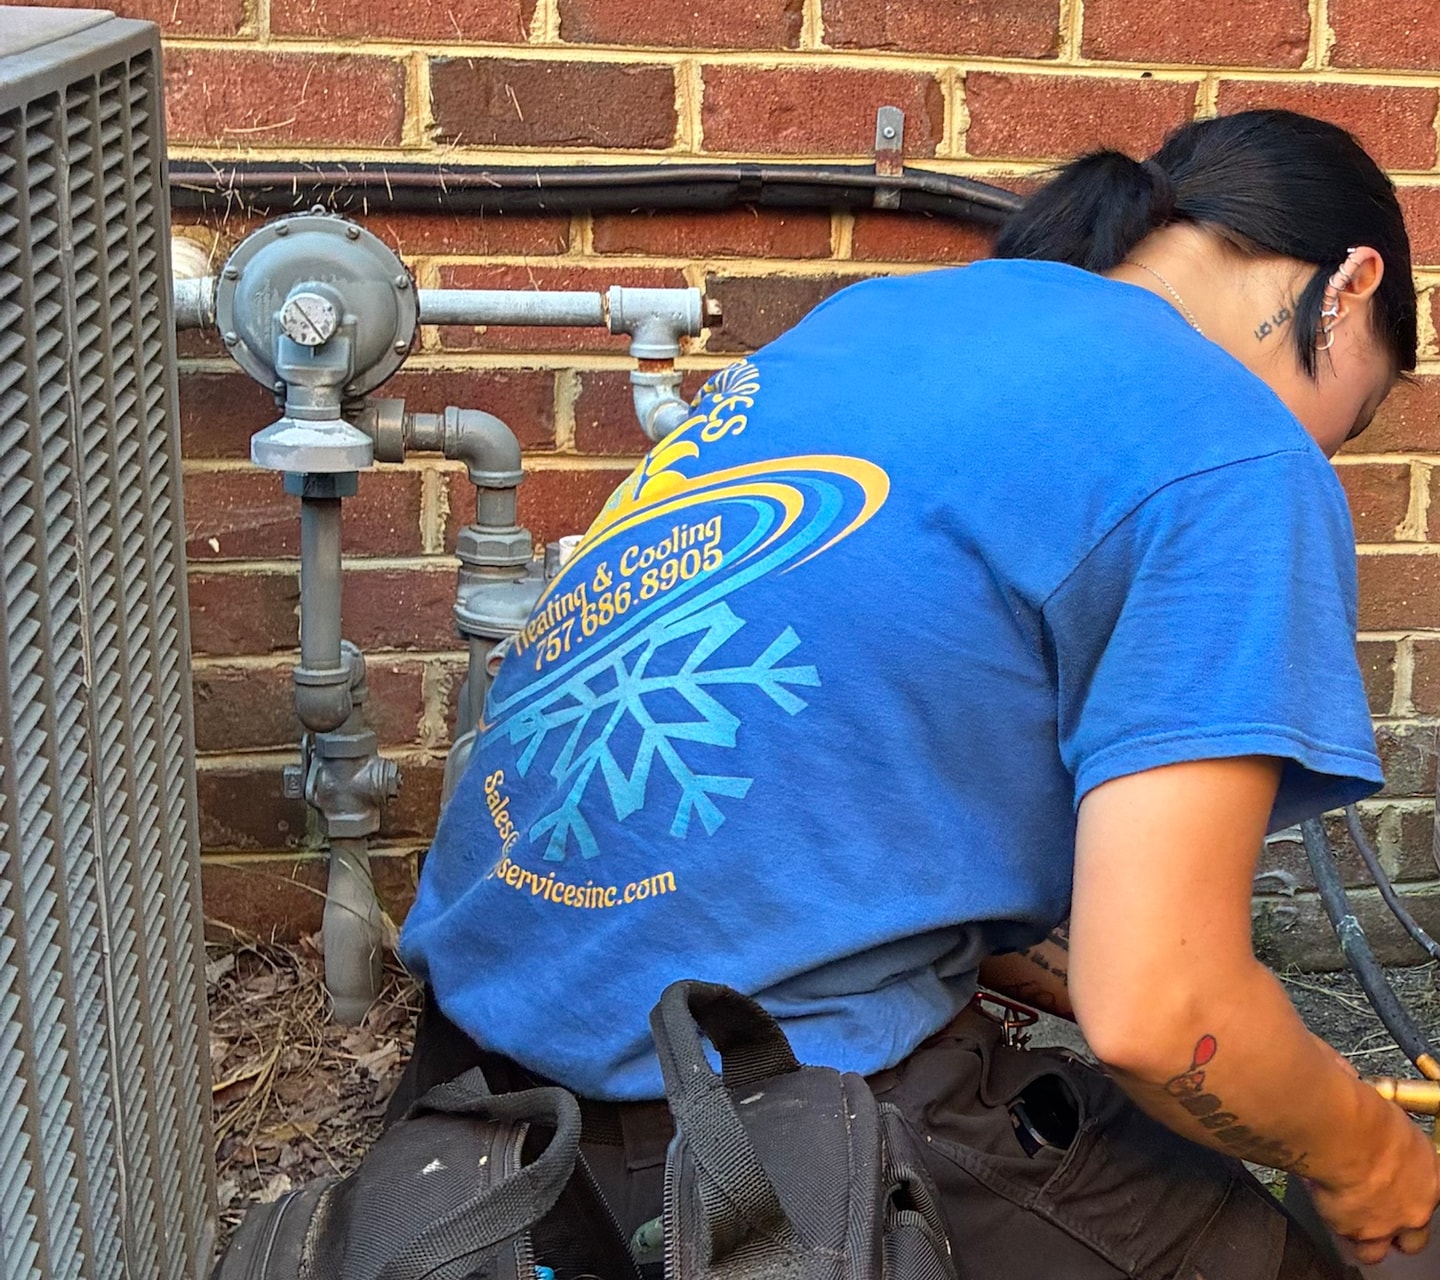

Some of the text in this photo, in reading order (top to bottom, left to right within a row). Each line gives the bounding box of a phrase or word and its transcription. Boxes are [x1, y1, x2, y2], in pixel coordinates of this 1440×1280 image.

[592, 561, 613, 593] &
[619, 515, 722, 576] Cooling
[535, 543, 724, 671] 757.686.8905
